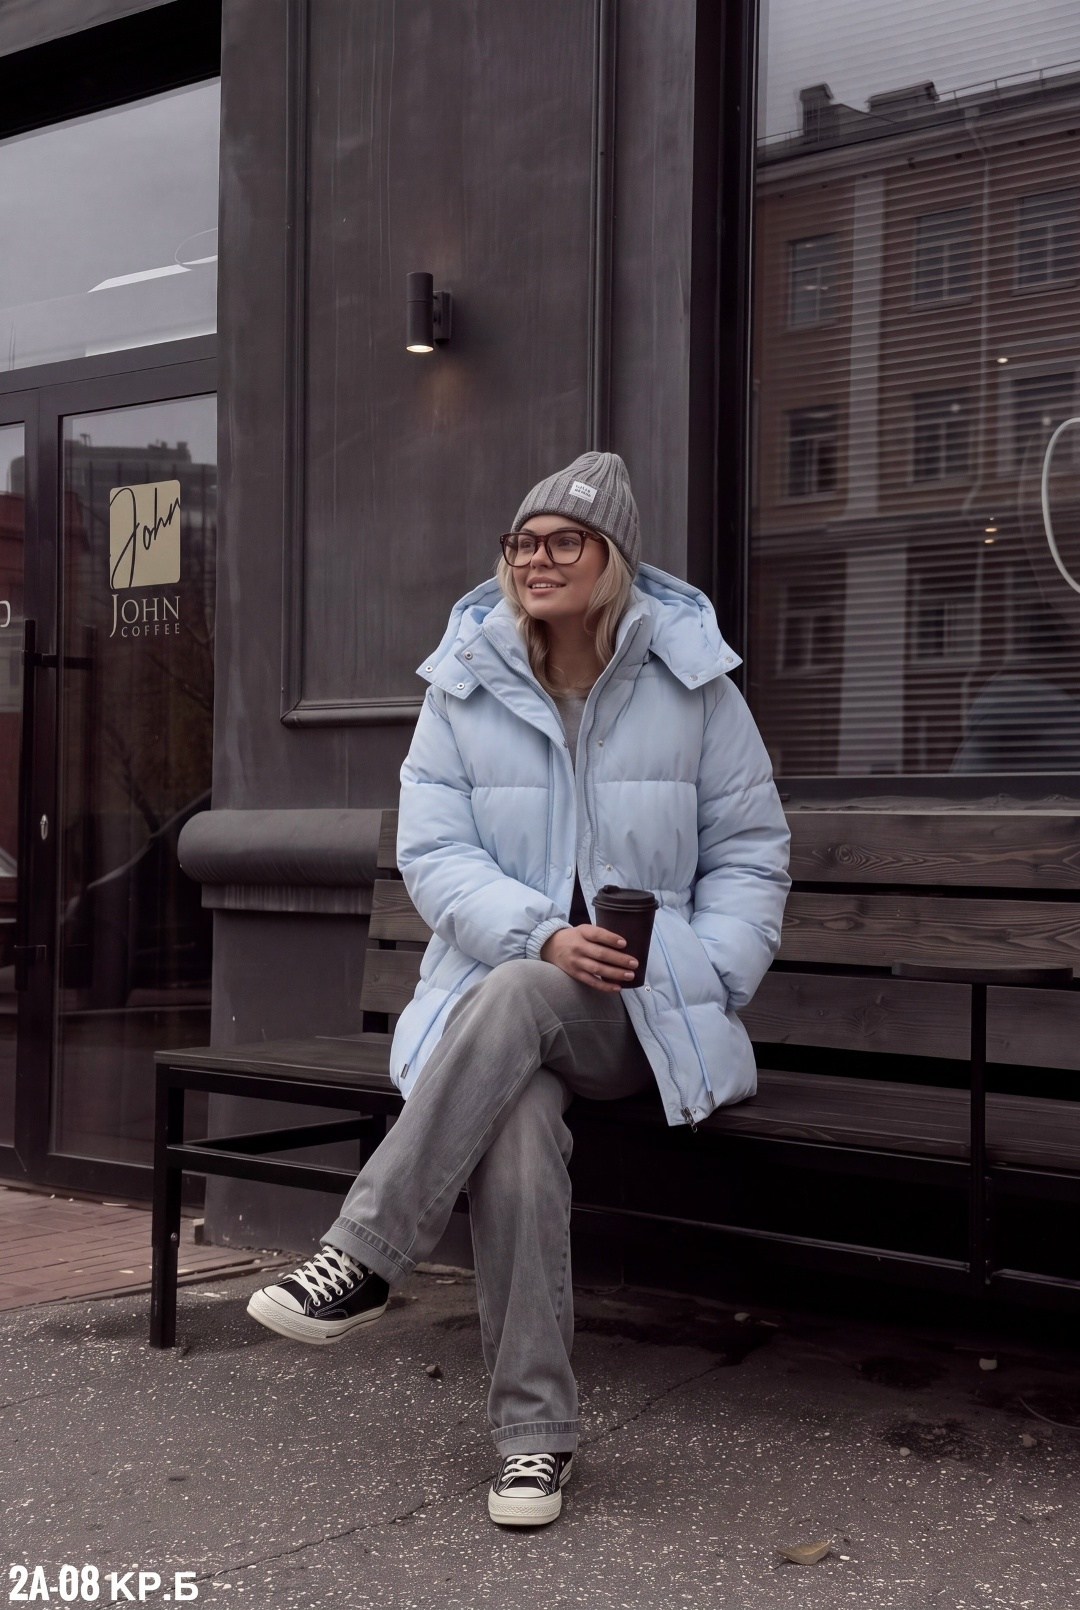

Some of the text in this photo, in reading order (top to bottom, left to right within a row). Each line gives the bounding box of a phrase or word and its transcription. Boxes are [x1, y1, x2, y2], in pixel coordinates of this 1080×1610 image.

[110, 488, 180, 588] John
[110, 594, 180, 637] JOHN
[121, 623, 180, 638] COFFEE
